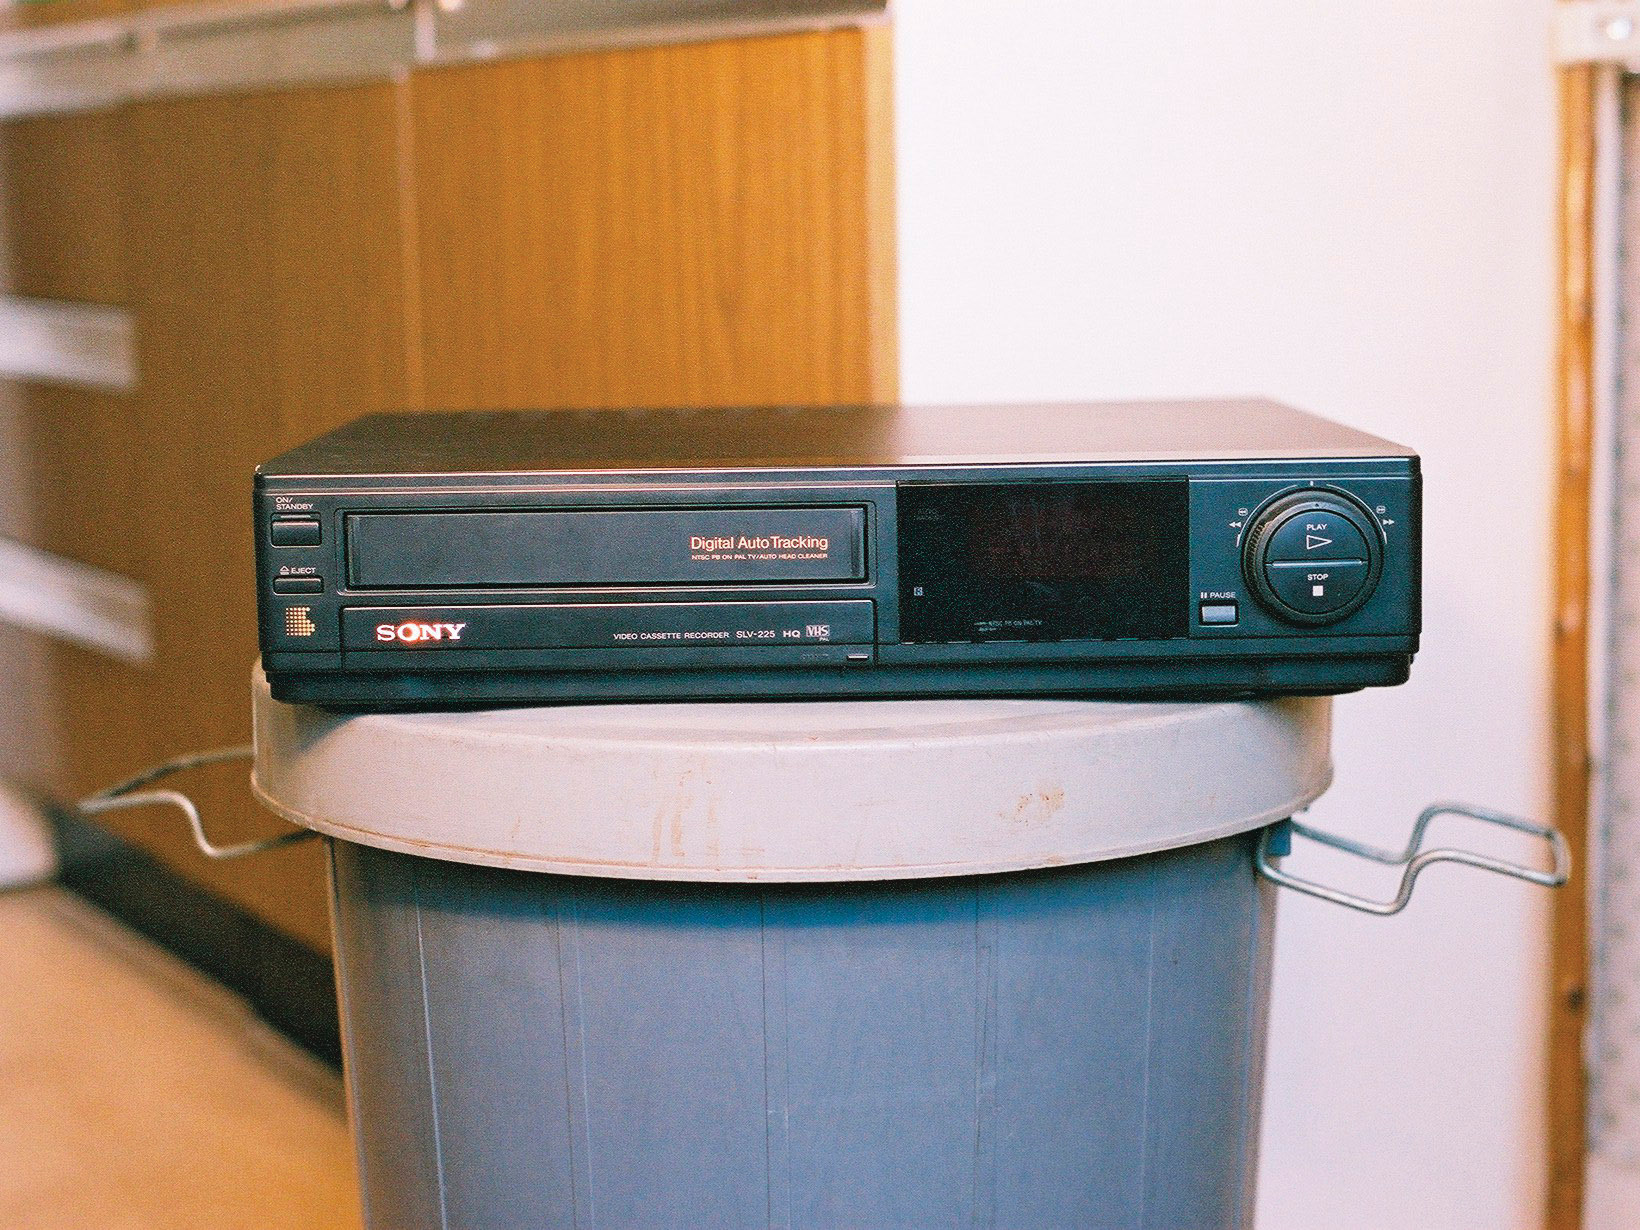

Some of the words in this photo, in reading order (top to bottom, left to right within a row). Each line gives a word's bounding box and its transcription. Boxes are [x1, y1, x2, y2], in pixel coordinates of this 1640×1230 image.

[275, 496, 293, 504] ON/
[275, 503, 314, 511] STANDBY
[1306, 523, 1328, 532] PLAY
[690, 536, 735, 552] Digital
[797, 552, 829, 560] CLEANER
[290, 567, 317, 575] EJECT
[1306, 573, 1330, 581] STOP
[1209, 591, 1237, 599] PAUSE
[375, 623, 467, 642] SONY
[612, 632, 639, 640] VIDEO
[640, 632, 682, 640] CASSETTE
[683, 631, 731, 639] RECORDER
[735, 630, 777, 639] SLV-225
[782, 630, 801, 639] HQ
[805, 624, 831, 638] VHS
